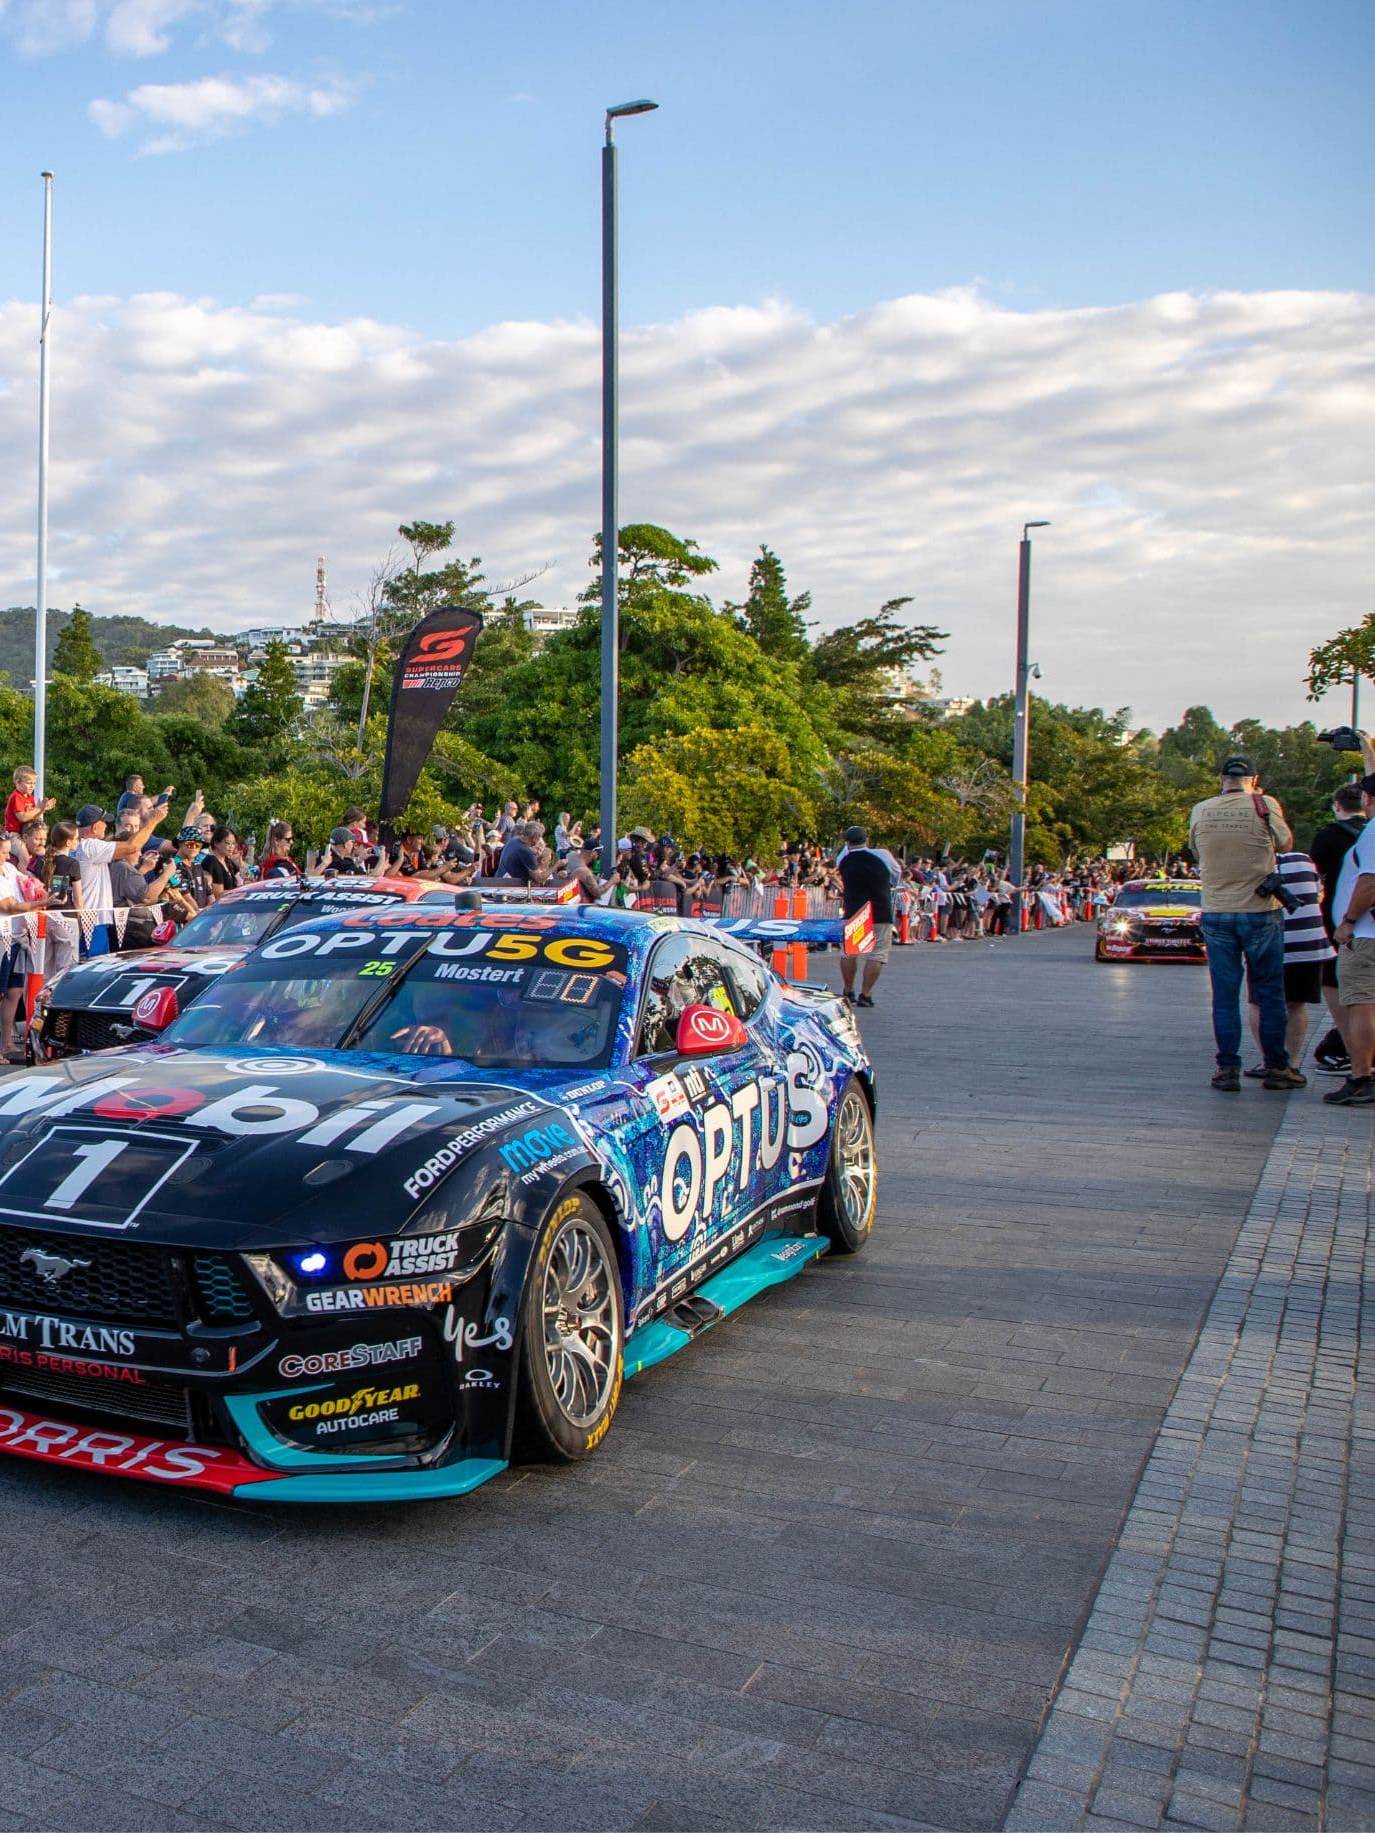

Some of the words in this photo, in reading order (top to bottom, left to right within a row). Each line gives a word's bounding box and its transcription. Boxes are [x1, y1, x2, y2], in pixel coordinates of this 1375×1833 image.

[404, 671, 461, 679] CHAMPIONSHIP
[405, 664, 462, 673] SUPERCARS
[424, 677, 461, 690] Repco
[244, 891, 316, 901] TRUCK
[315, 891, 403, 905] ASSIST
[343, 907, 564, 930] Coates
[358, 960, 397, 977] 25
[434, 963, 526, 983] Mostert
[119, 977, 158, 1006] 1
[567, 1079, 607, 1101] DUNLOP
[403, 1148, 459, 1200] FORD
[446, 1099, 542, 1156] PERFORMANCE
[498, 1123, 576, 1174] move
[660, 1052, 829, 1242] OPTUS
[43, 1139, 130, 1210] 1
[388, 1231, 459, 1259] TRUCK
[383, 1250, 459, 1278] ASSIST
[305, 1281, 453, 1313] GEARWRENCH
[34, 1314, 137, 1357] TRANS
[443, 1303, 514, 1363] yes
[36, 1353, 147, 1385] PERSONAL
[458, 1380, 501, 1391] OAKLEY
[316, 1407, 400, 1435] AUTOCARE
